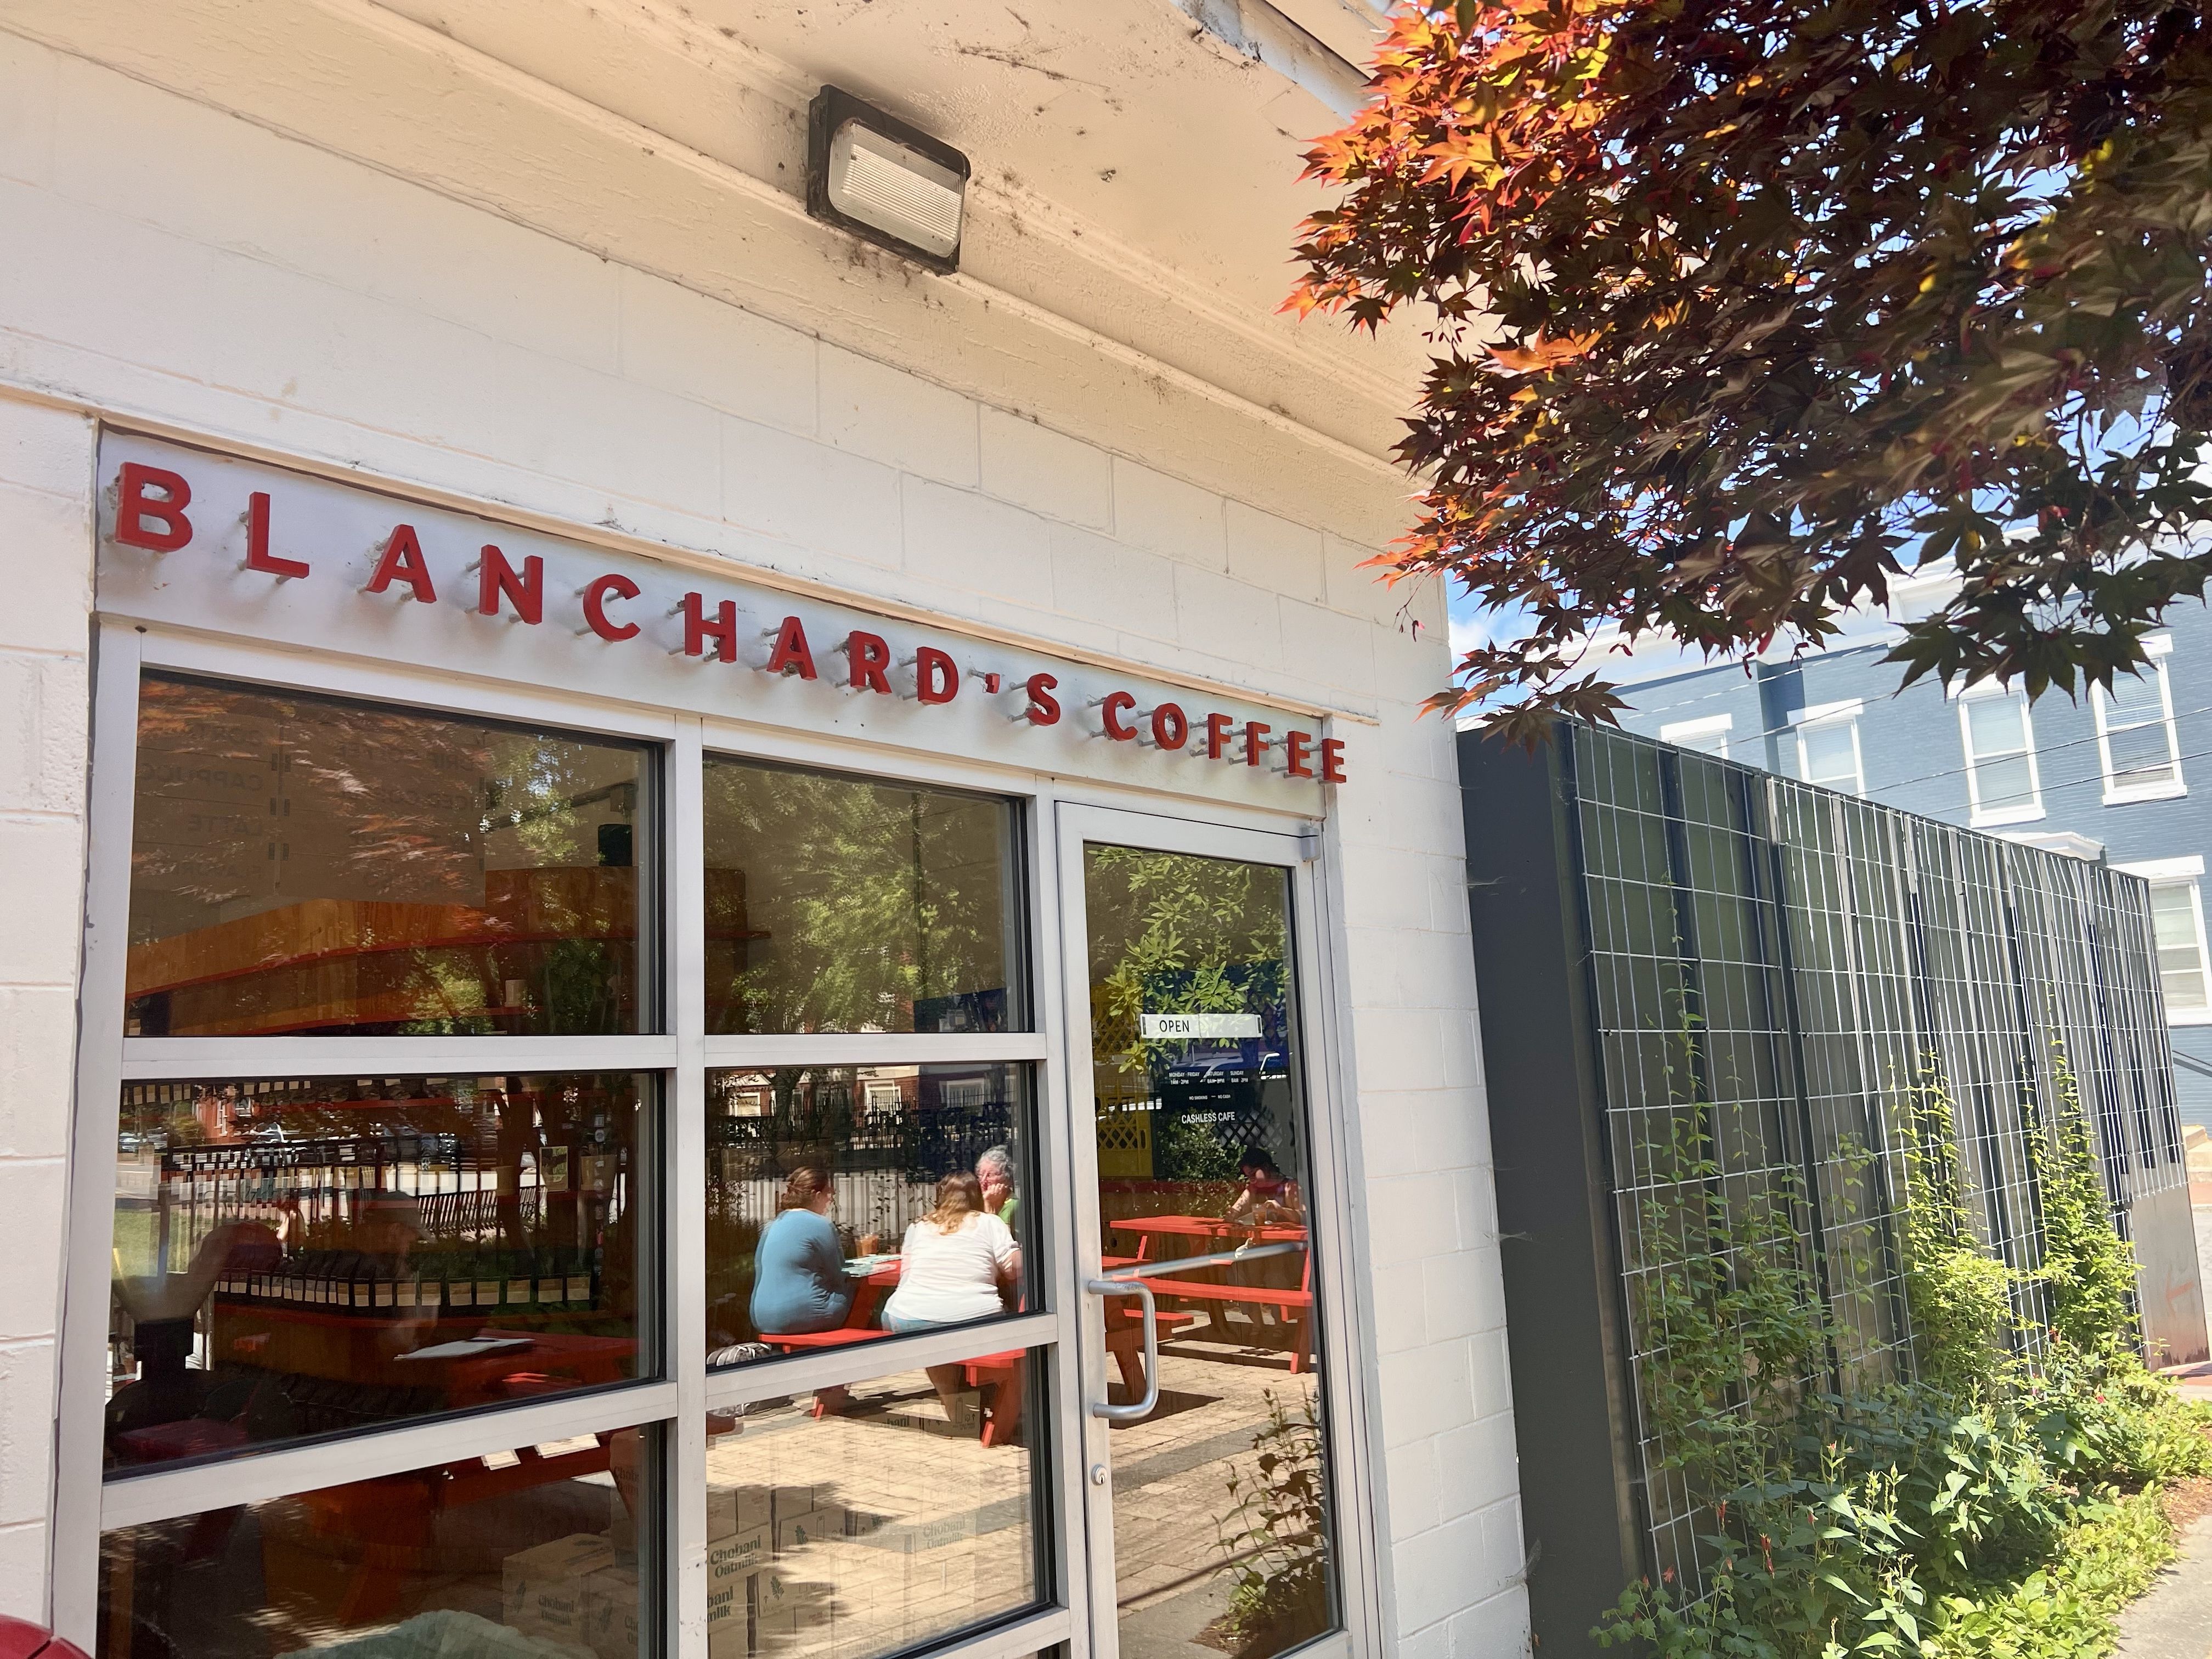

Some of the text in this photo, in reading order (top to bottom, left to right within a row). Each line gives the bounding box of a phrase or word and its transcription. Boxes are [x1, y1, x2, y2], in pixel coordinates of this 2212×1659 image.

[115, 461, 1347, 785] BLANCHARD'S COFFEE
[1159, 1020, 1190, 1032] OPEN
[1182, 1111, 1235, 1124] CASHLESS CAFE
[710, 1534, 761, 1565] Chobani
[708, 1585, 733, 1609] bani
[708, 1604, 731, 1623] milk
